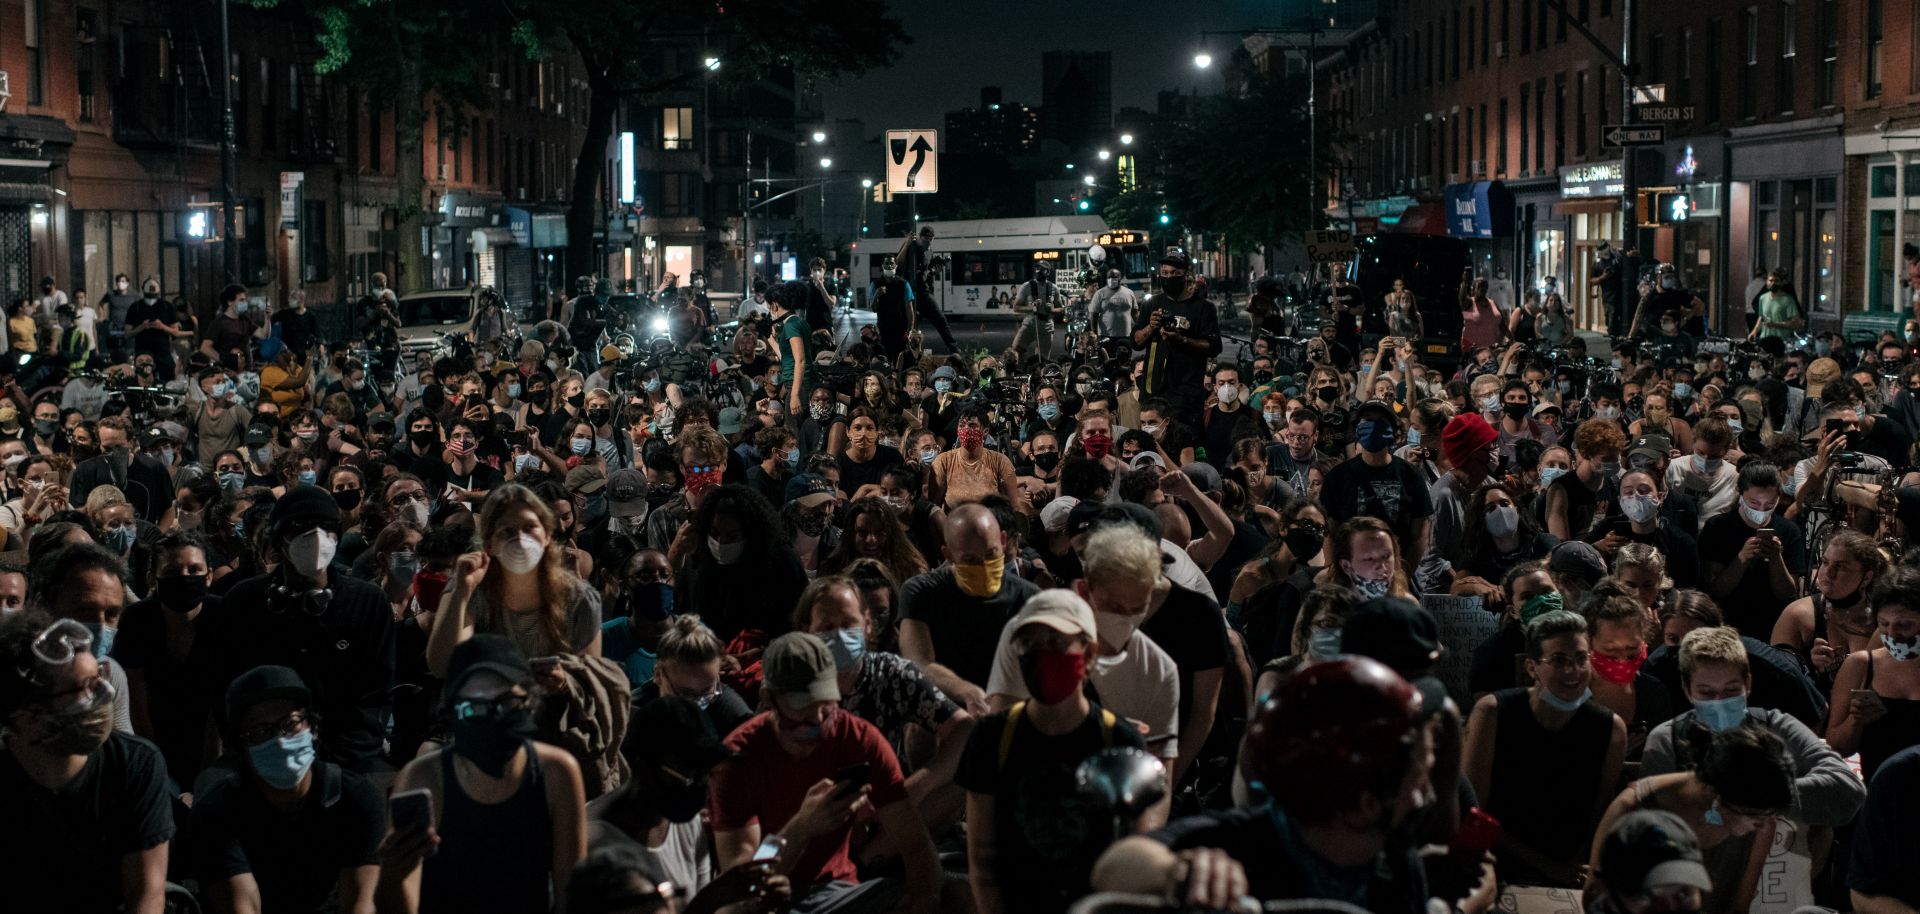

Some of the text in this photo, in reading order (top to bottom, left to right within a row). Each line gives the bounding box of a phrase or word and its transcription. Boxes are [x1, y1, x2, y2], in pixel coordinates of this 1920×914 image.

[1642, 106, 1696, 121] BERGEN ST
[1613, 131, 1657, 142] ONE WAY
[1583, 164, 1622, 182] EXCHANGE
[1317, 231, 1350, 243] END
[1640, 438, 1647, 446] 3
[1426, 597, 1474, 610] AHMAUD
